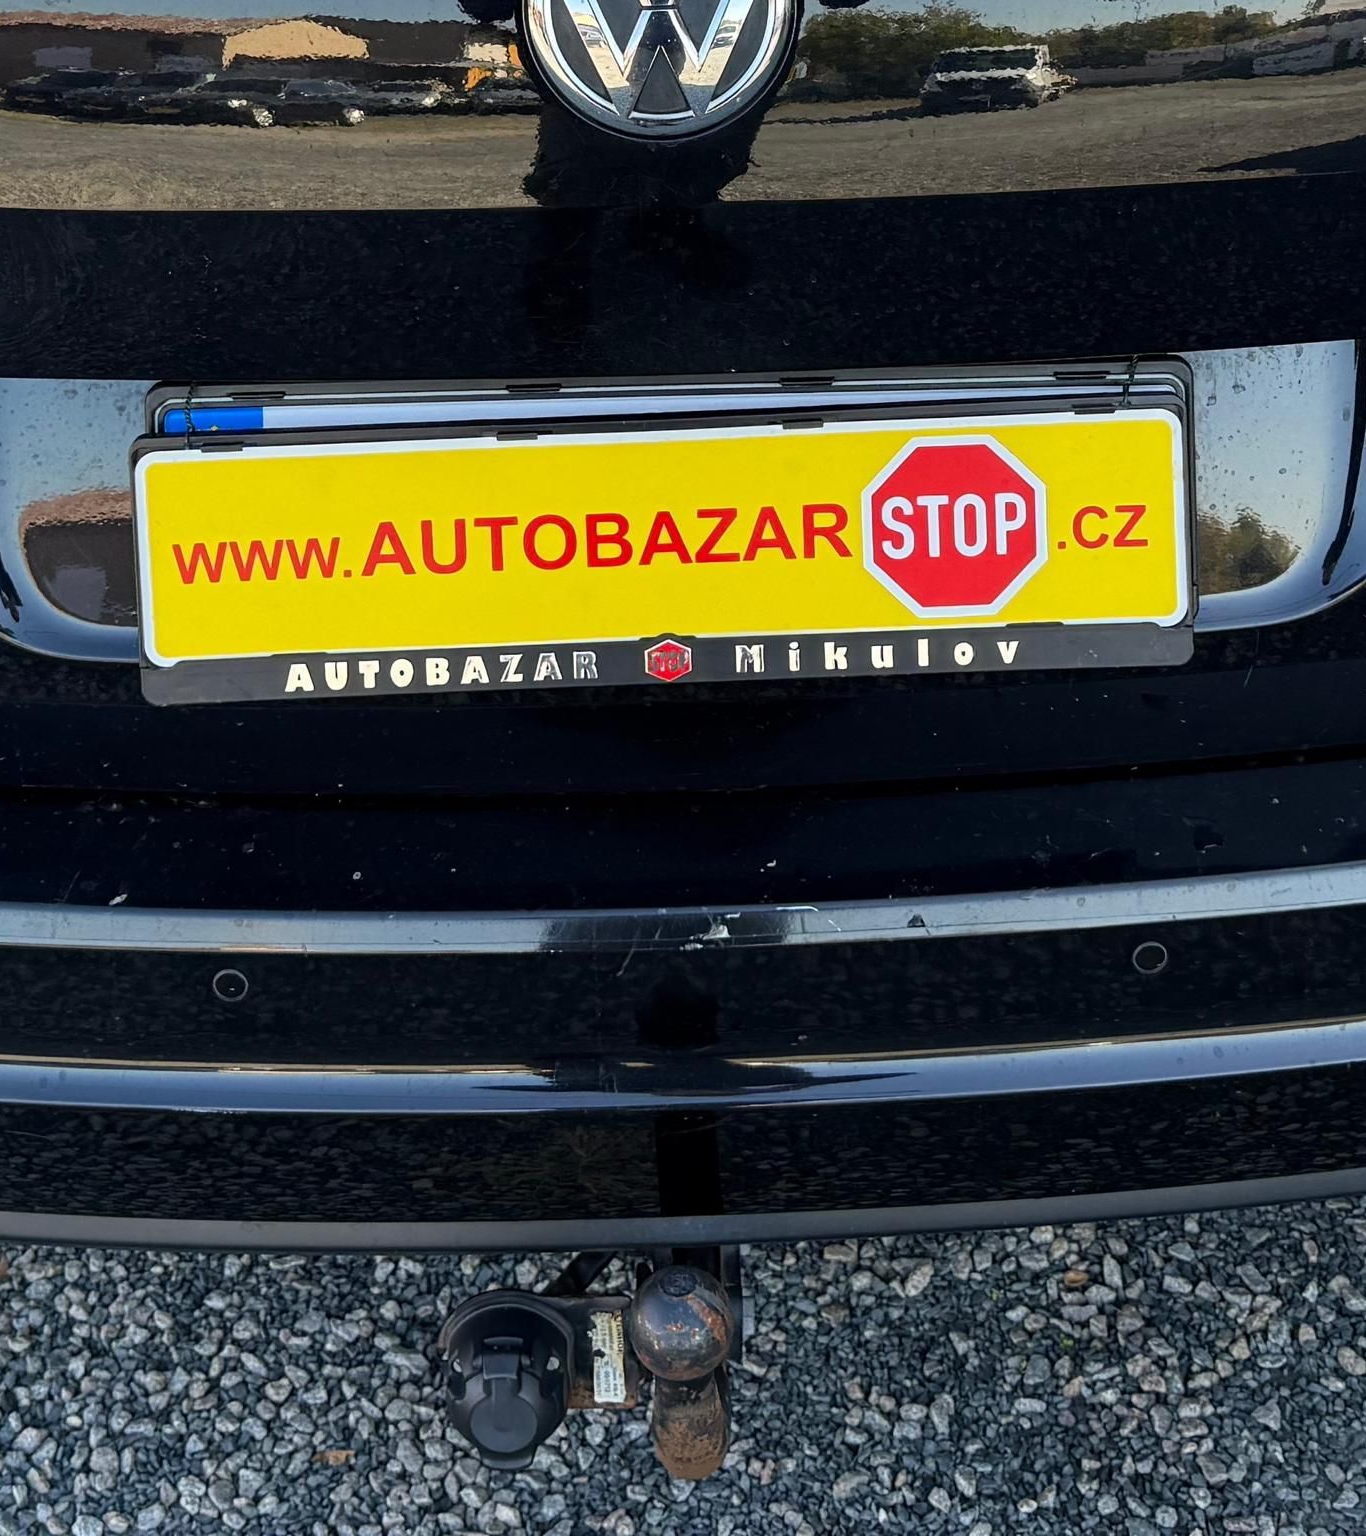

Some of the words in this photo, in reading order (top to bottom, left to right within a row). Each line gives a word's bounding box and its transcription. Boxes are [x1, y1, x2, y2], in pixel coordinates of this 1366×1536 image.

[880, 492, 1027, 560] STOP
[284, 650, 599, 693] AUTOBAZAR
[734, 637, 1020, 674] Mikulov
